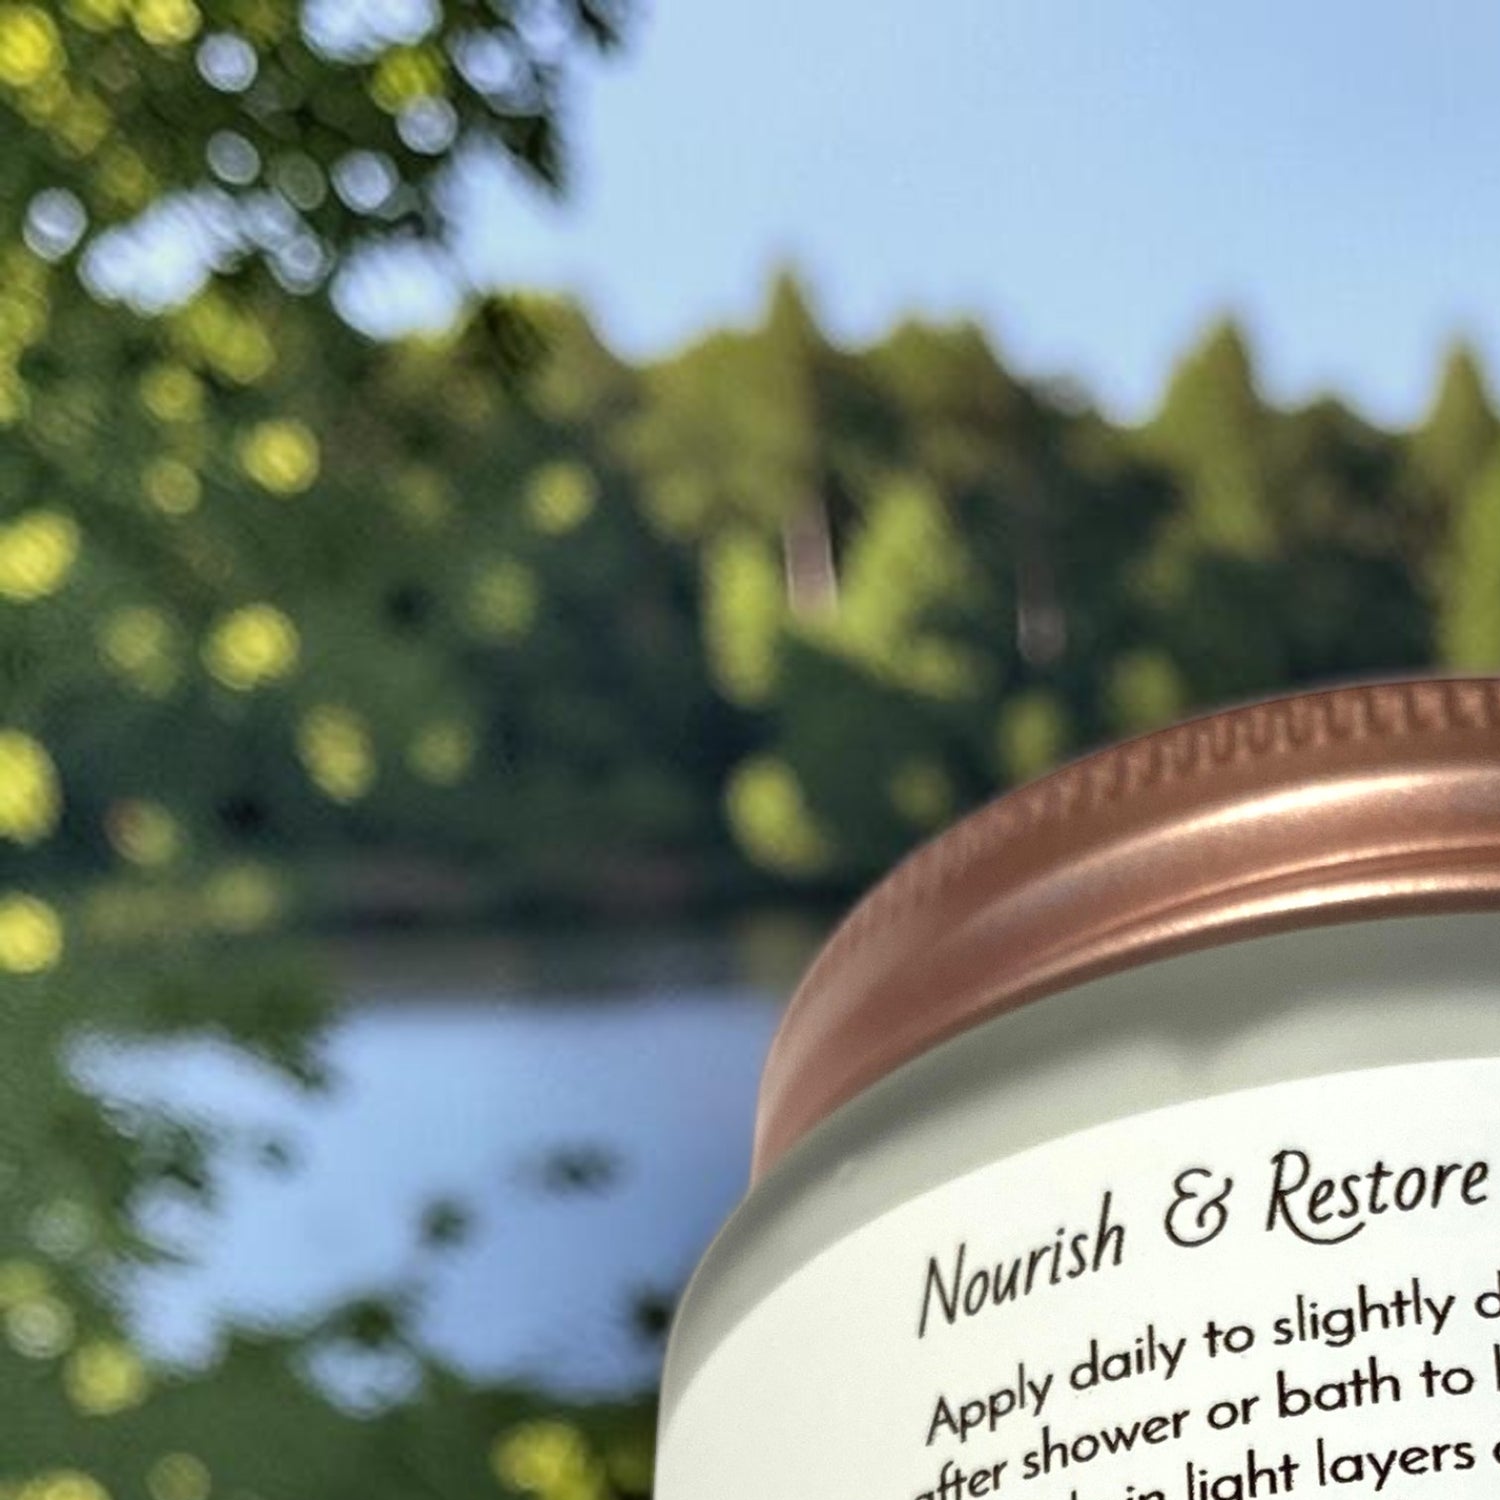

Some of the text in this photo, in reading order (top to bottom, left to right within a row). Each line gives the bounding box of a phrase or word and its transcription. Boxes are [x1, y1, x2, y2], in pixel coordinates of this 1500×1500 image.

[917, 1189, 1127, 1340] Nourish
[1162, 1166, 1235, 1249] &
[1264, 1148, 1491, 1247] Restore
[924, 1361, 1055, 1448] Apply
[1068, 1322, 1188, 1392] daily
[1201, 1319, 1257, 1359] to
[1272, 1276, 1458, 1349] slightly
[1021, 1408, 1192, 1481] shower
[1205, 1394, 1261, 1432] or
[1275, 1354, 1402, 1420] bath
[1417, 1358, 1477, 1399] to
[1315, 1436, 1477, 1493] layers
